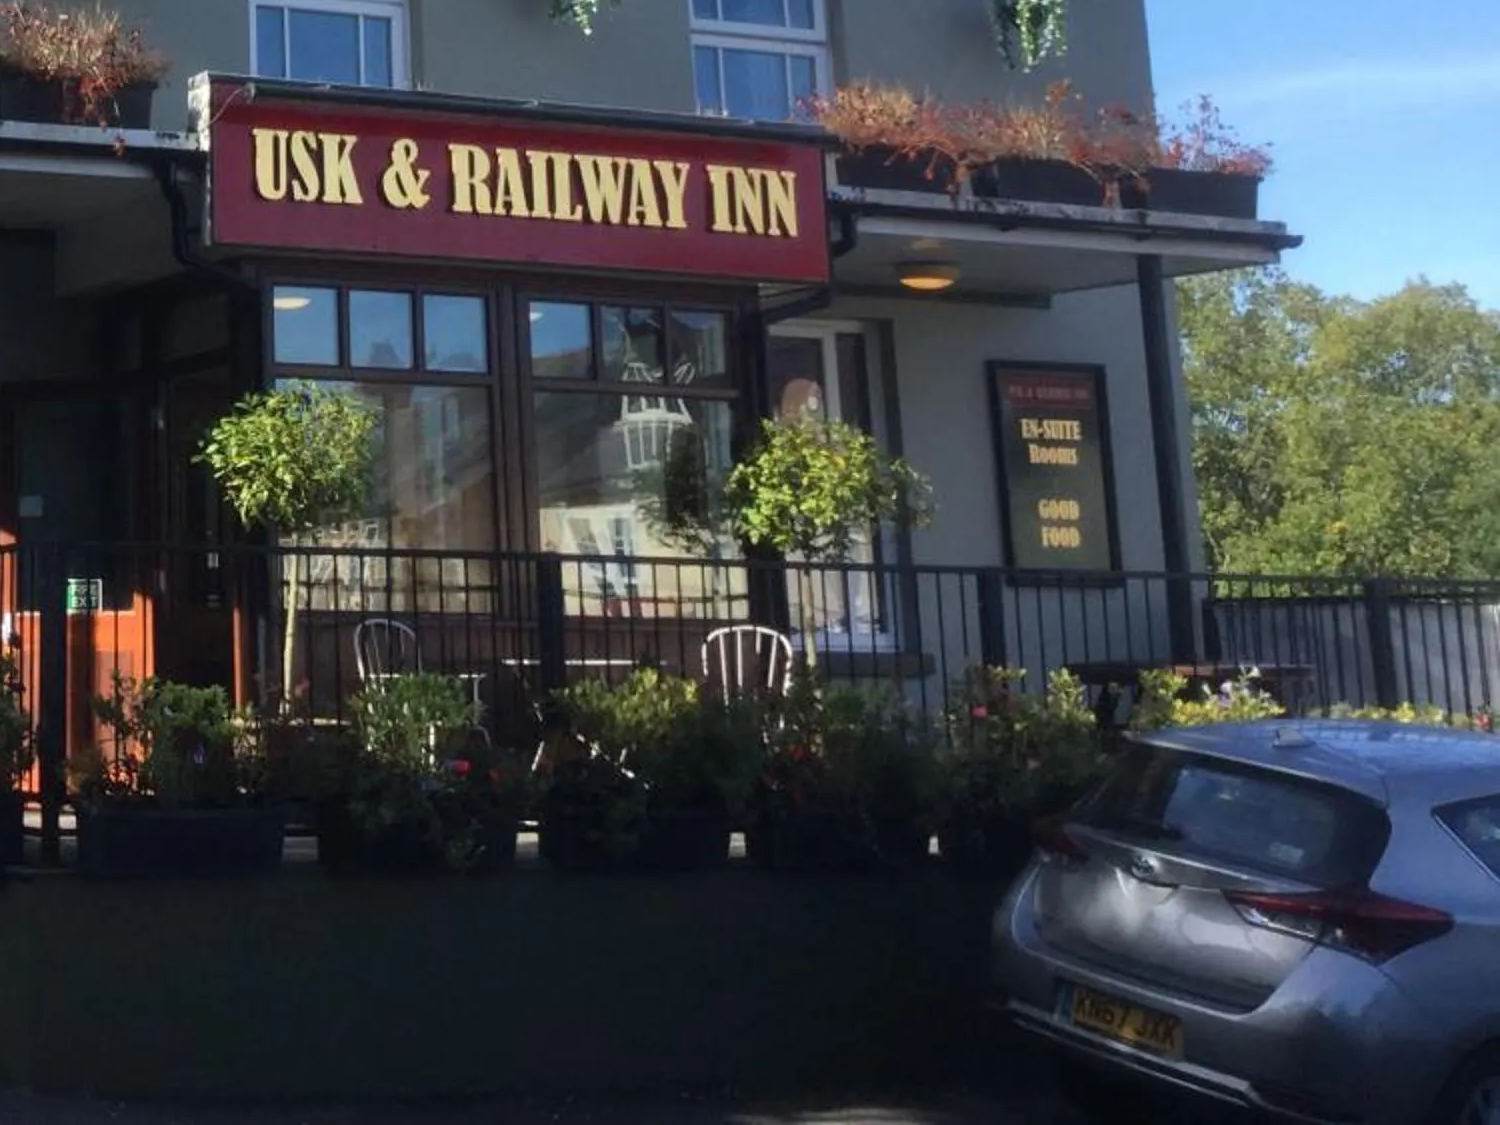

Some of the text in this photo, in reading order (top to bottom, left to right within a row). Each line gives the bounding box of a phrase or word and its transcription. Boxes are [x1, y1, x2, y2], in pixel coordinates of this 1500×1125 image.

[251, 127, 799, 238] USK & RAILWAY INN
[71, 596, 98, 608] EXT
